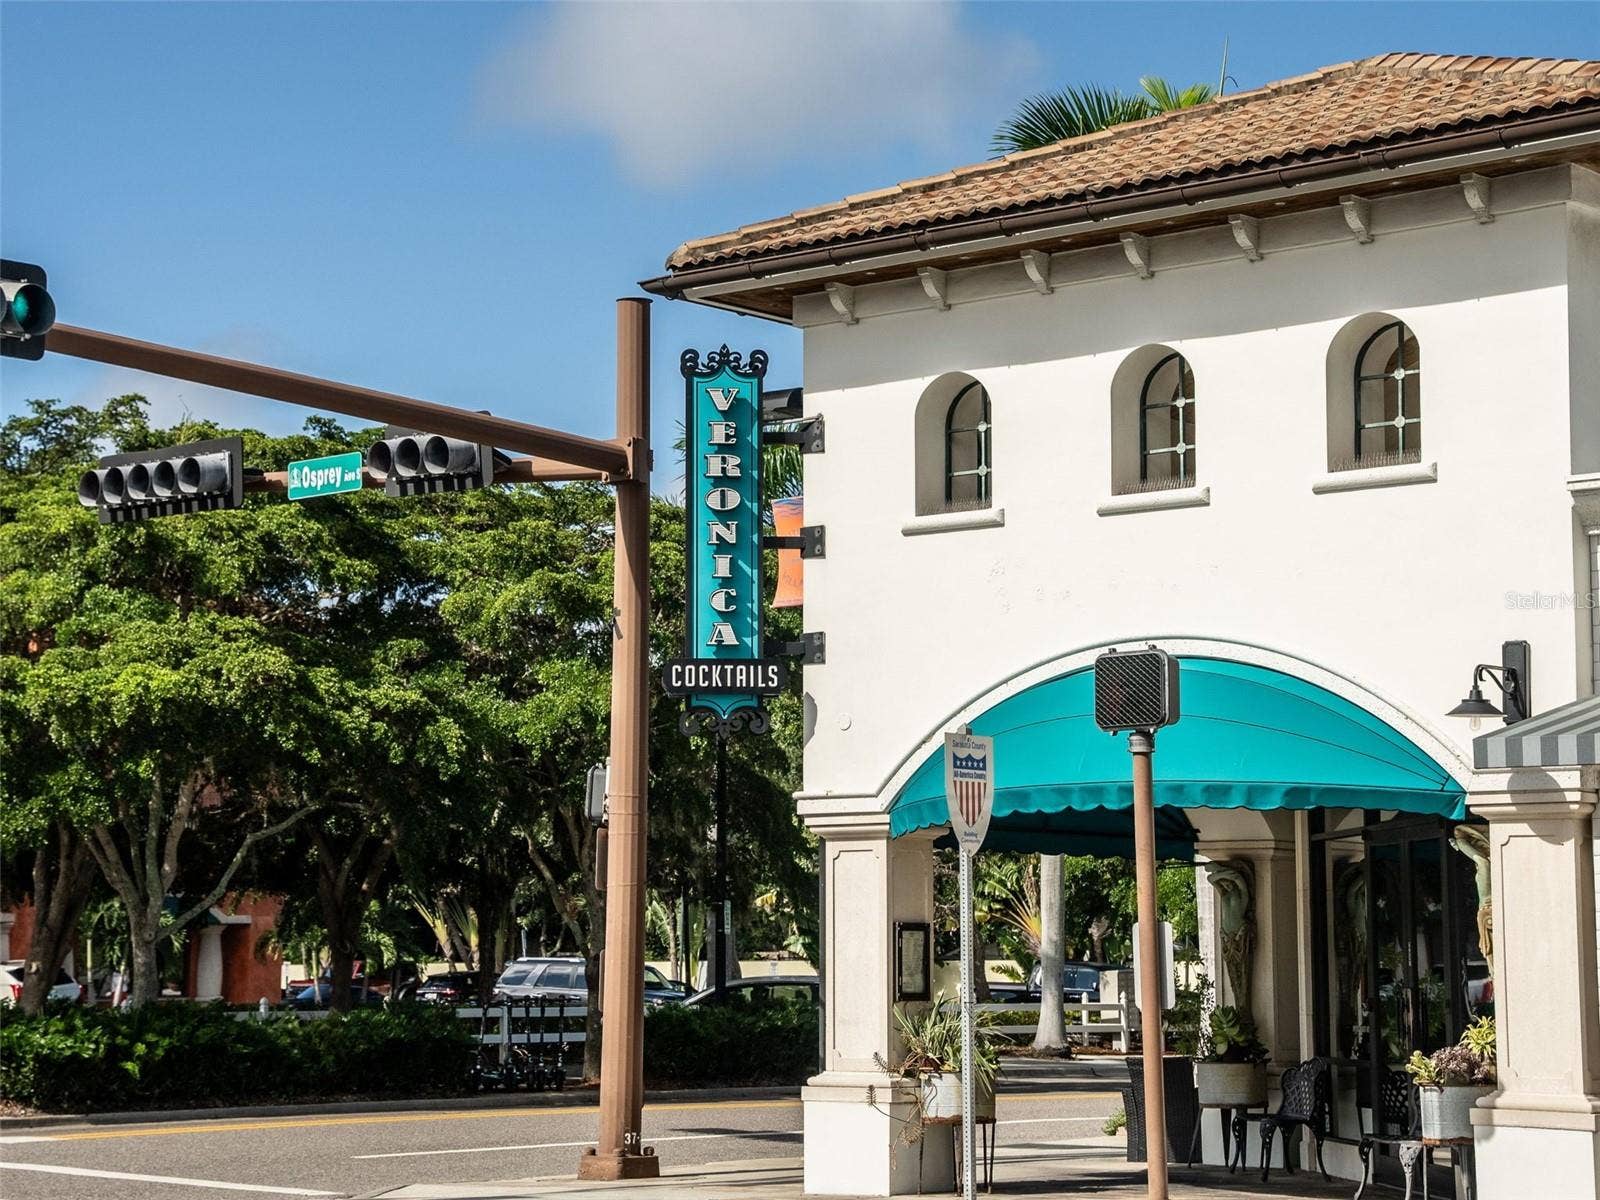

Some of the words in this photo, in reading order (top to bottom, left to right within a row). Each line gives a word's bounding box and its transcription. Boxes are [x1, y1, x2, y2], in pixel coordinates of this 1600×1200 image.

[302, 466, 342, 491] Osprey
[704, 387, 741, 645] VERONICA
[671, 664, 779, 689] COCKTAILS
